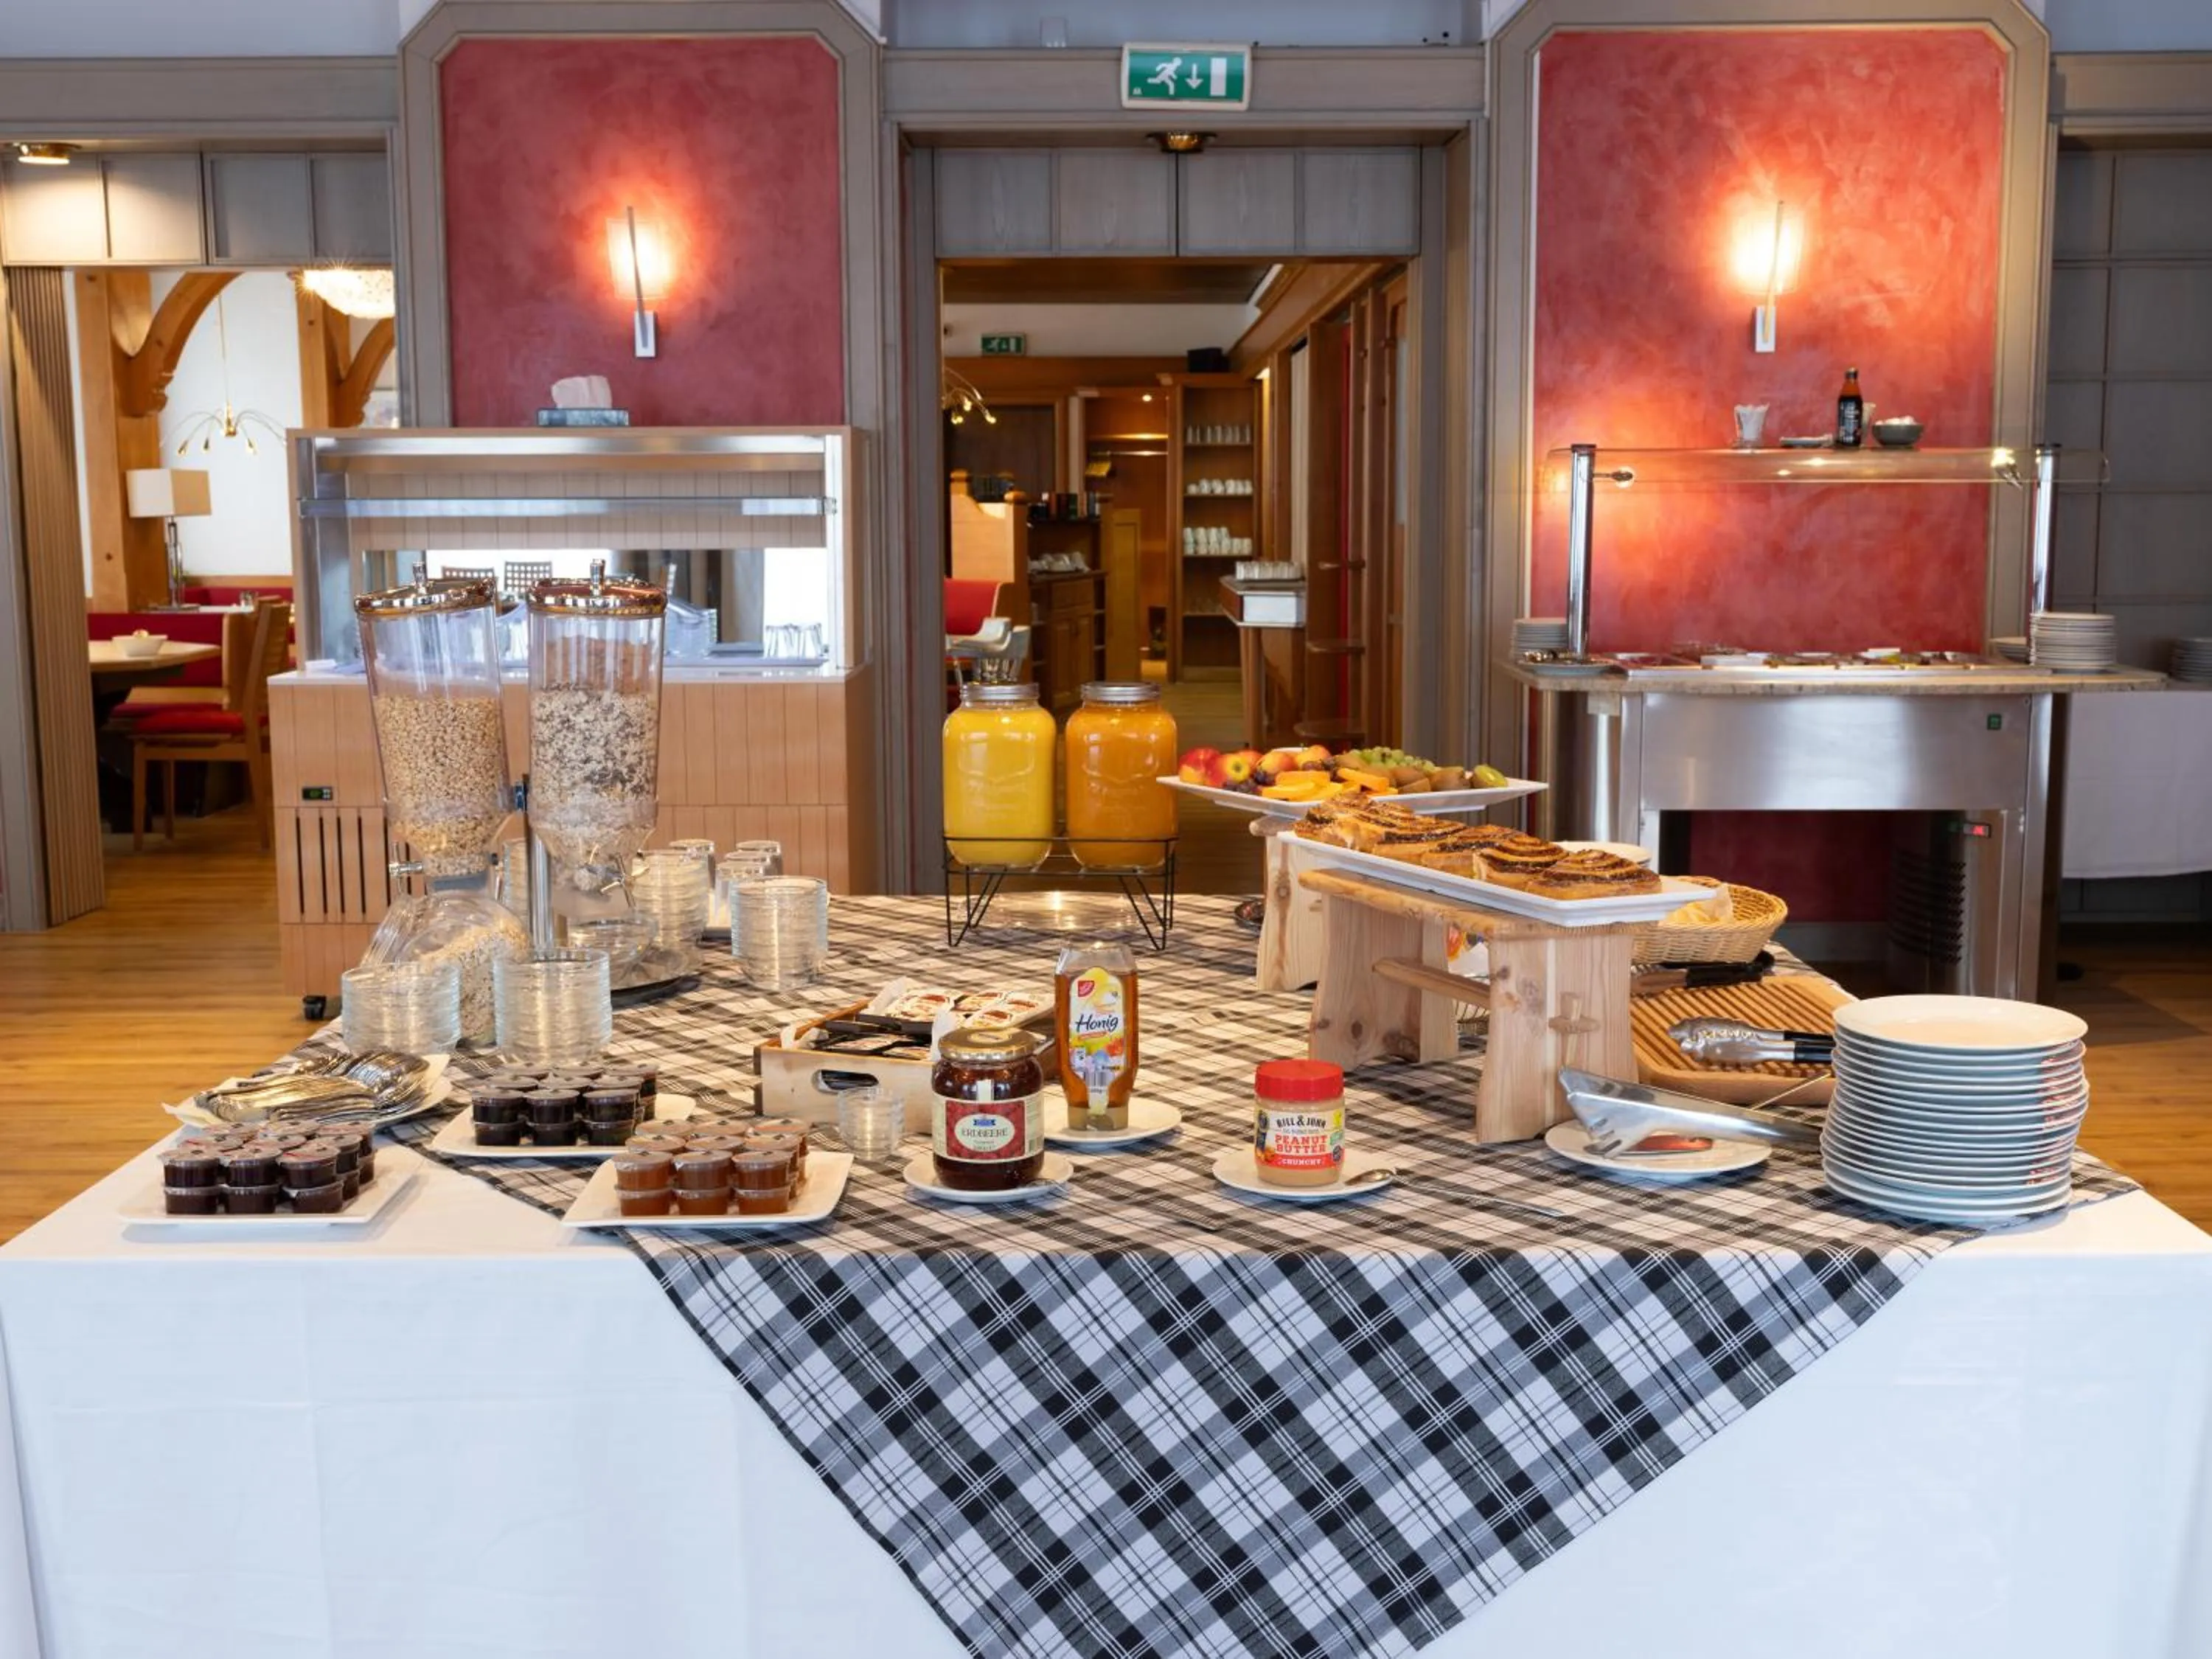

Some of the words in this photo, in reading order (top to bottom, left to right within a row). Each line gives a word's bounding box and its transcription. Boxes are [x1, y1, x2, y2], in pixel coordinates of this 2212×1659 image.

[1075, 1014, 1119, 1032] Honig
[1297, 1114, 1304, 1127] &
[1275, 1135, 1327, 1145] PEANUT
[1276, 1144, 1326, 1154] BUTTER
